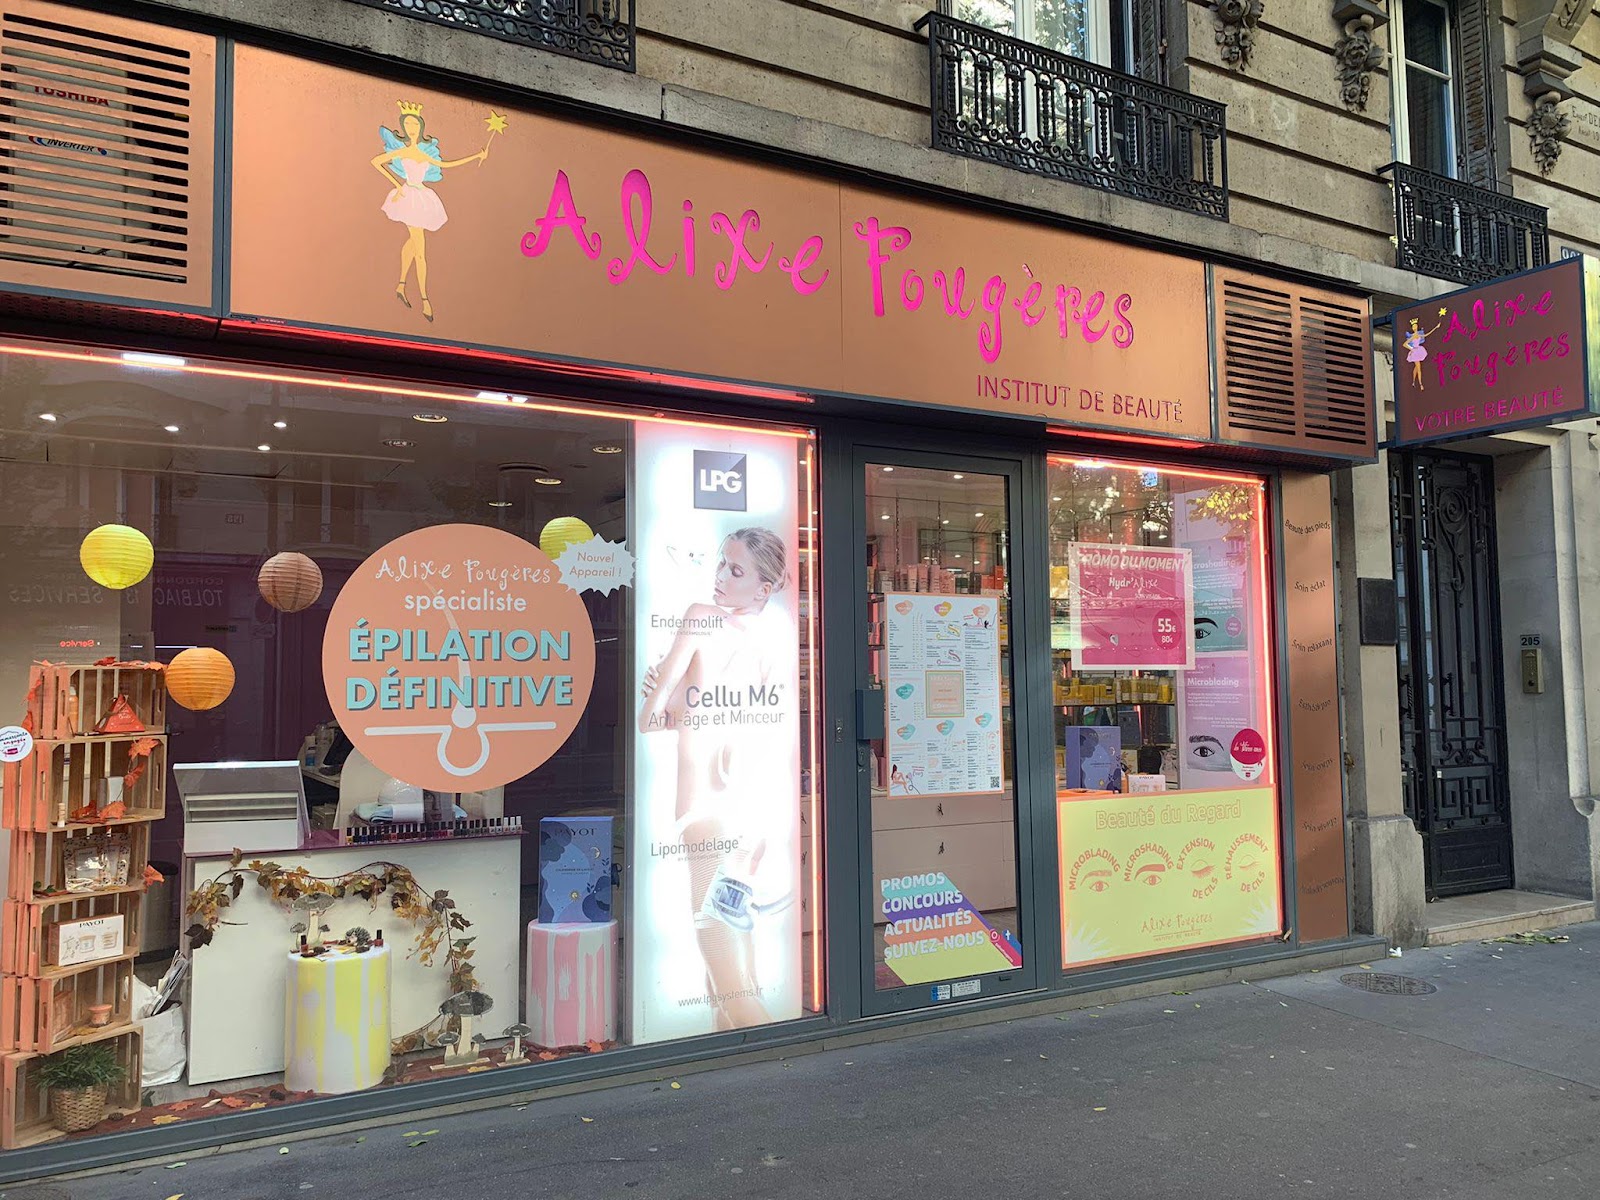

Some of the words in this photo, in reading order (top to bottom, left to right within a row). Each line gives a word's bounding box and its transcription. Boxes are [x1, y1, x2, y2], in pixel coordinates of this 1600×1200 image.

[47, 138, 95, 152] INVERTER
[520, 168, 830, 295] Alixe
[853, 216, 1134, 363] Fougères
[1442, 290, 1553, 343] Alixe
[1432, 332, 1571, 388] Fougères
[977, 375, 1070, 408] INSTITUT
[1079, 389, 1104, 412] DE
[1113, 393, 1183, 423] BEAUTÉ
[1415, 405, 1475, 431] VOTRE
[1484, 387, 1564, 419] BEAUTÉ
[700, 469, 743, 494] LPG
[1284, 518, 1304, 535] Beauté
[1304, 525, 1315, 534] des
[1314, 520, 1331, 533] pieds
[577, 552, 614, 563] Nouvel
[1138, 556, 1187, 571] MOMENT
[1192, 557, 1237, 569] croshading
[375, 555, 453, 582] Alixe
[463, 558, 551, 590] Fougères
[569, 566, 615, 579] Appareil
[1294, 581, 1308, 593] Soin
[1310, 580, 1327, 592] éclat
[404, 588, 527, 616] spécialiste
[1157, 618, 1176, 633] 55€
[349, 617, 571, 662] ÉPILATION
[1292, 639, 1306, 653] Soin
[1307, 638, 1333, 653] relaxant
[1521, 637, 1540, 646] 205
[346, 666, 573, 710] DÉFINITIVE
[1187, 677, 1239, 688] Microblading
[686, 685, 741, 709] Cellu
[648, 710, 707, 731] Anti-âge
[713, 713, 726, 725] et
[730, 709, 785, 725] Minceur
[1096, 805, 1156, 830] Beauté
[1161, 805, 1181, 824] du
[1186, 799, 1241, 824] Regard
[555, 828, 597, 836] PAYOT
[1124, 843, 1174, 882] MICROSHADING
[1176, 837, 1215, 870] EXTENSION
[1069, 848, 1120, 890] MICROBLADING
[880, 871, 945, 891] PROMOS
[1192, 889, 1203, 899] DE
[1203, 876, 1218, 897] CILS
[1240, 882, 1251, 892] DE
[1251, 870, 1265, 891] CILS
[882, 890, 963, 913] CONCOURS
[79, 919, 104, 929] PAYOT
[884, 908, 972, 937] ACTUALITÉS
[1141, 915, 1172, 933] Alixe
[1176, 913, 1213, 930] Fougères
[884, 930, 985, 960] SUIVEZ-NOUS
[678, 986, 764, 1008] www.lpgsystems.fr
